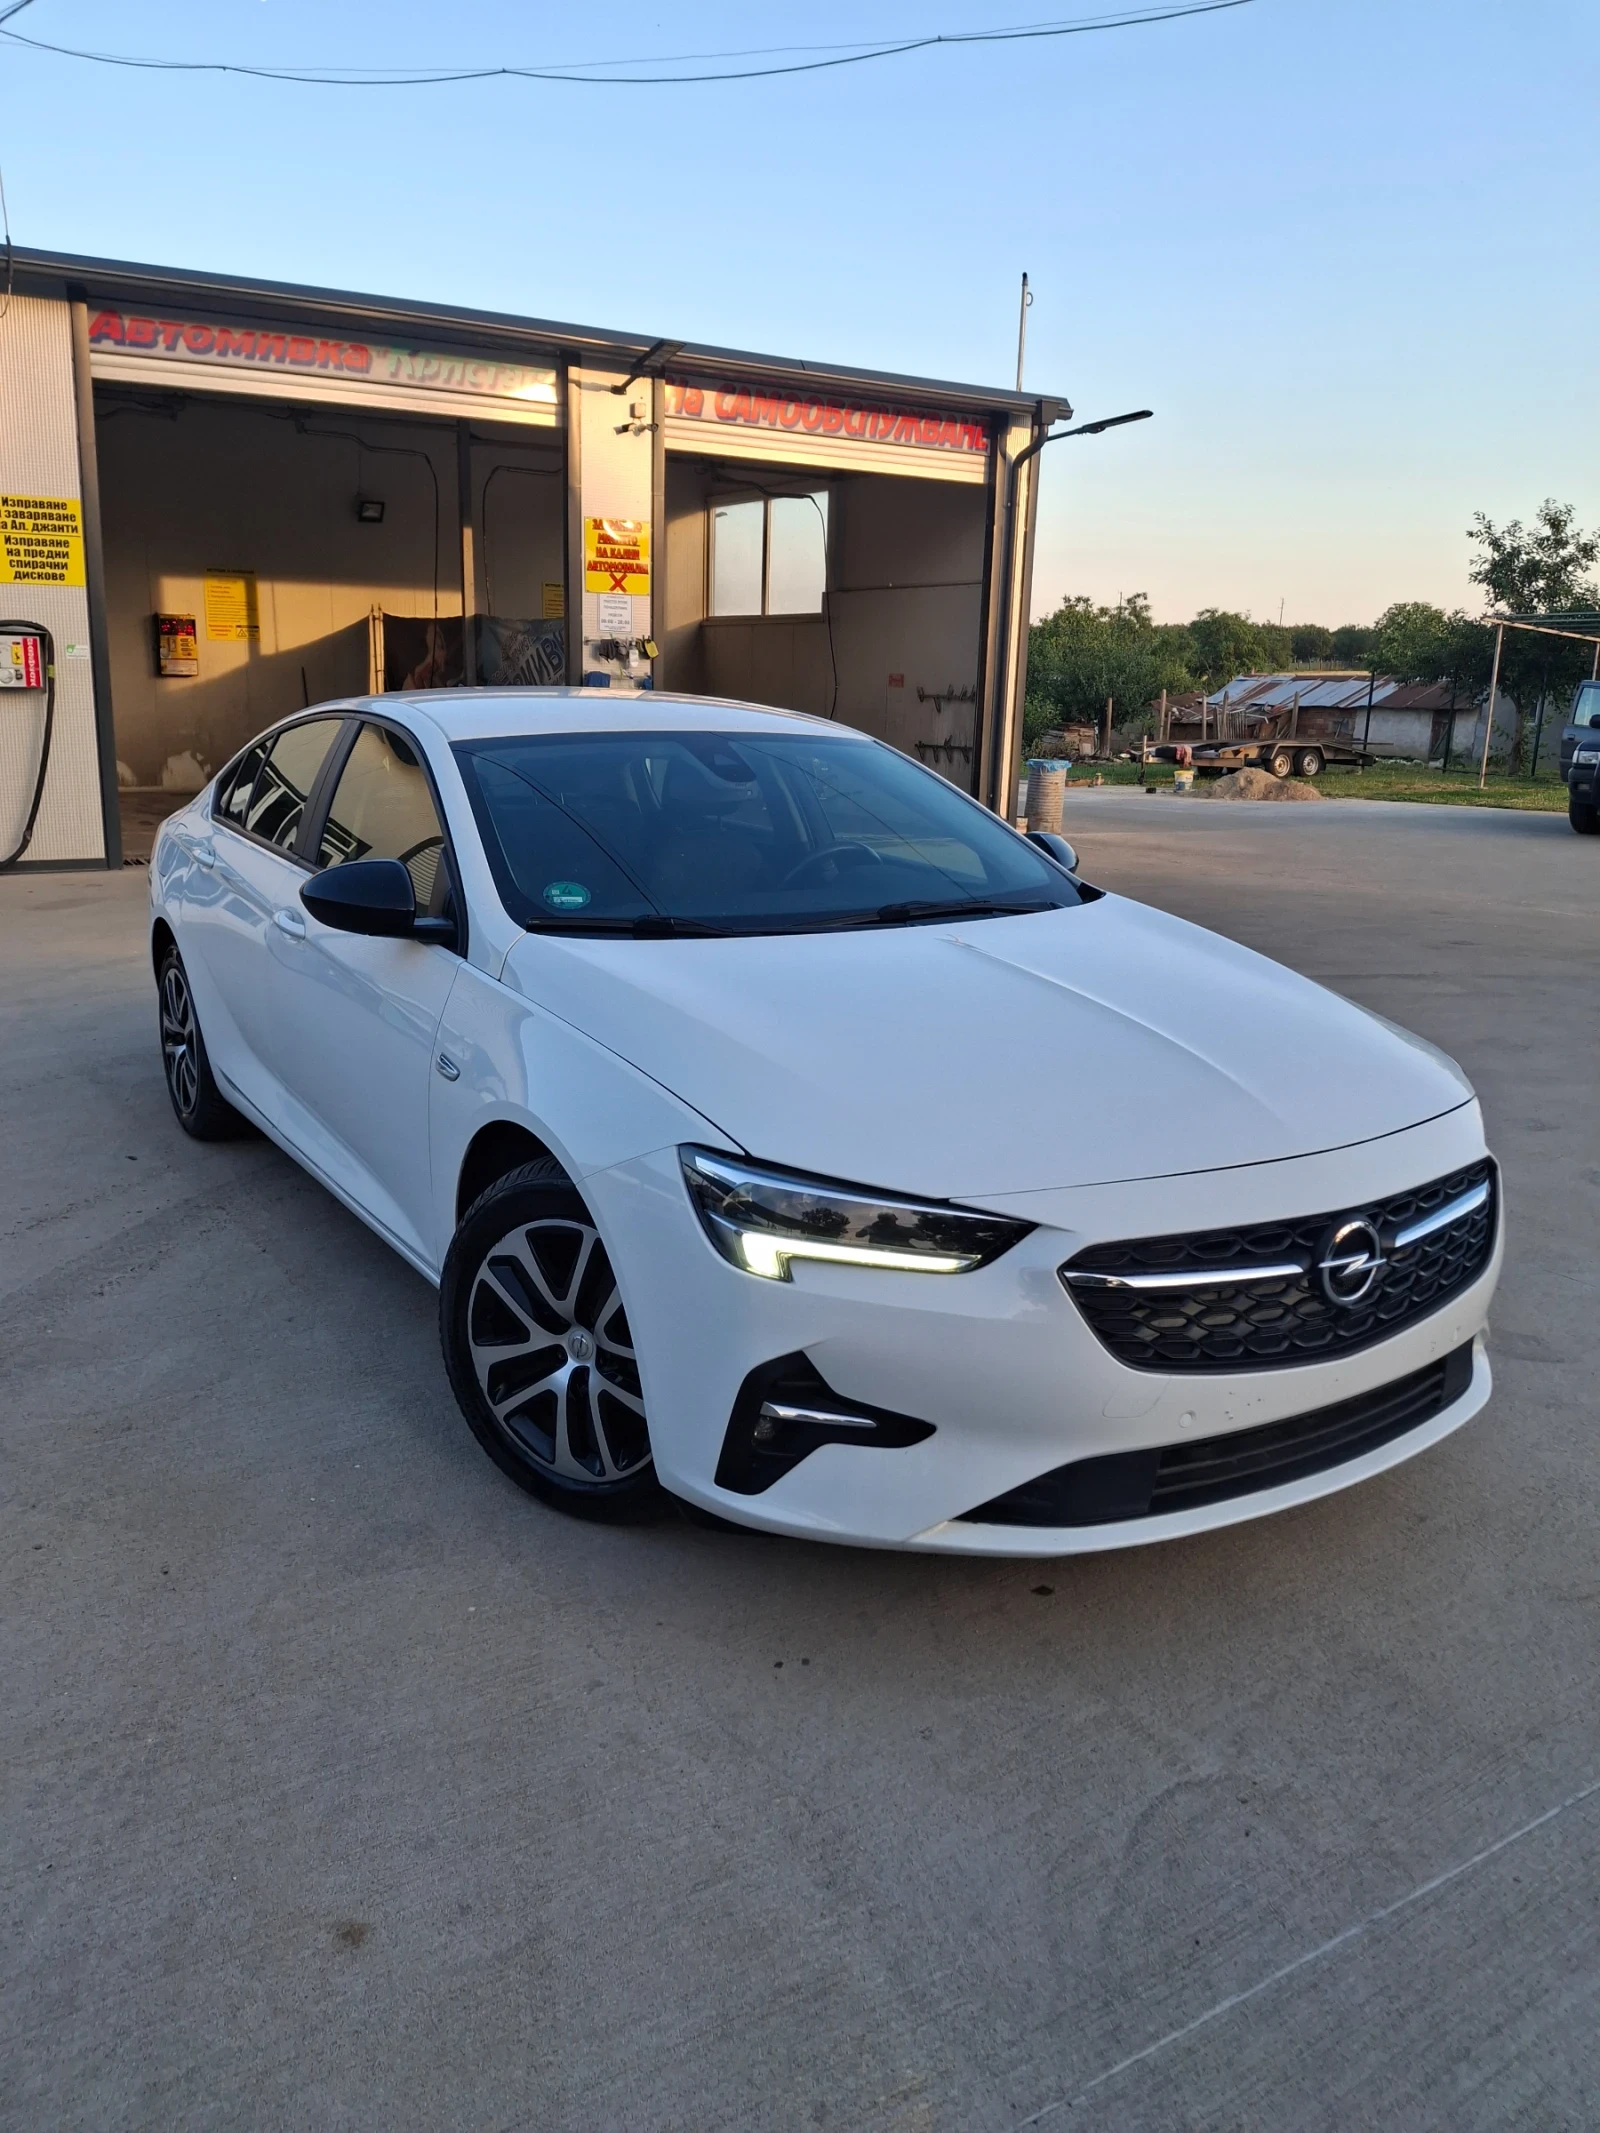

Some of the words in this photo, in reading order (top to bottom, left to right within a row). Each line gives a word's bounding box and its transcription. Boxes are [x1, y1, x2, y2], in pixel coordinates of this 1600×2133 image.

[1, 496, 67, 510] Изправяне
[4, 509, 76, 522] заваряване
[31, 522, 78, 533] джанти
[4, 534, 70, 548] Изправяне
[6, 547, 21, 557] на
[24, 548, 69, 560] предни
[9, 559, 68, 570] спирачни
[13, 570, 65, 581] дискове
